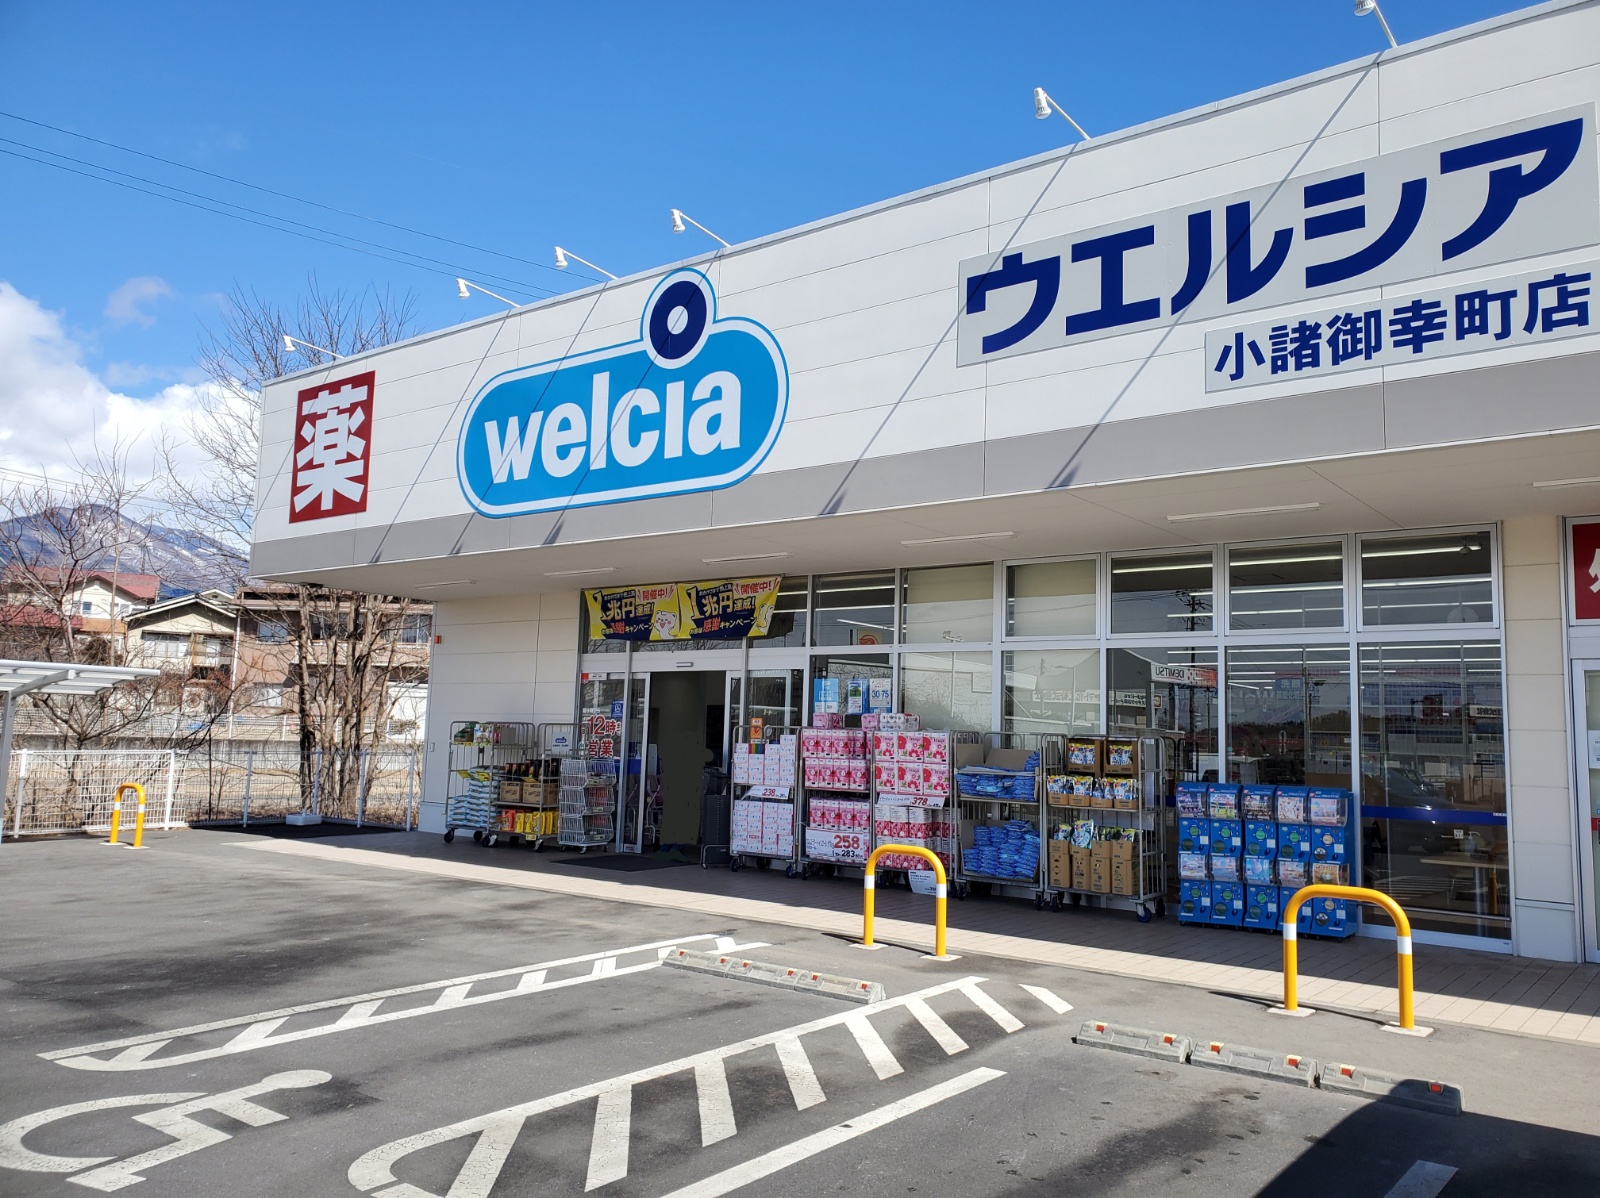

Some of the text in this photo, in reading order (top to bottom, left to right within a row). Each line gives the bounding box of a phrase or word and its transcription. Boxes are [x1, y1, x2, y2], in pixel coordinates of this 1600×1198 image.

[966, 118, 1583, 355] ウエルシア
[1214, 272, 1592, 382] 小諸御幸町店
[293, 384, 368, 513] 薬
[484, 370, 742, 484] welcia
[589, 738, 614, 758] 営業
[763, 788, 776, 797] 238
[911, 797, 928, 806] 378
[834, 834, 860, 850] 258
